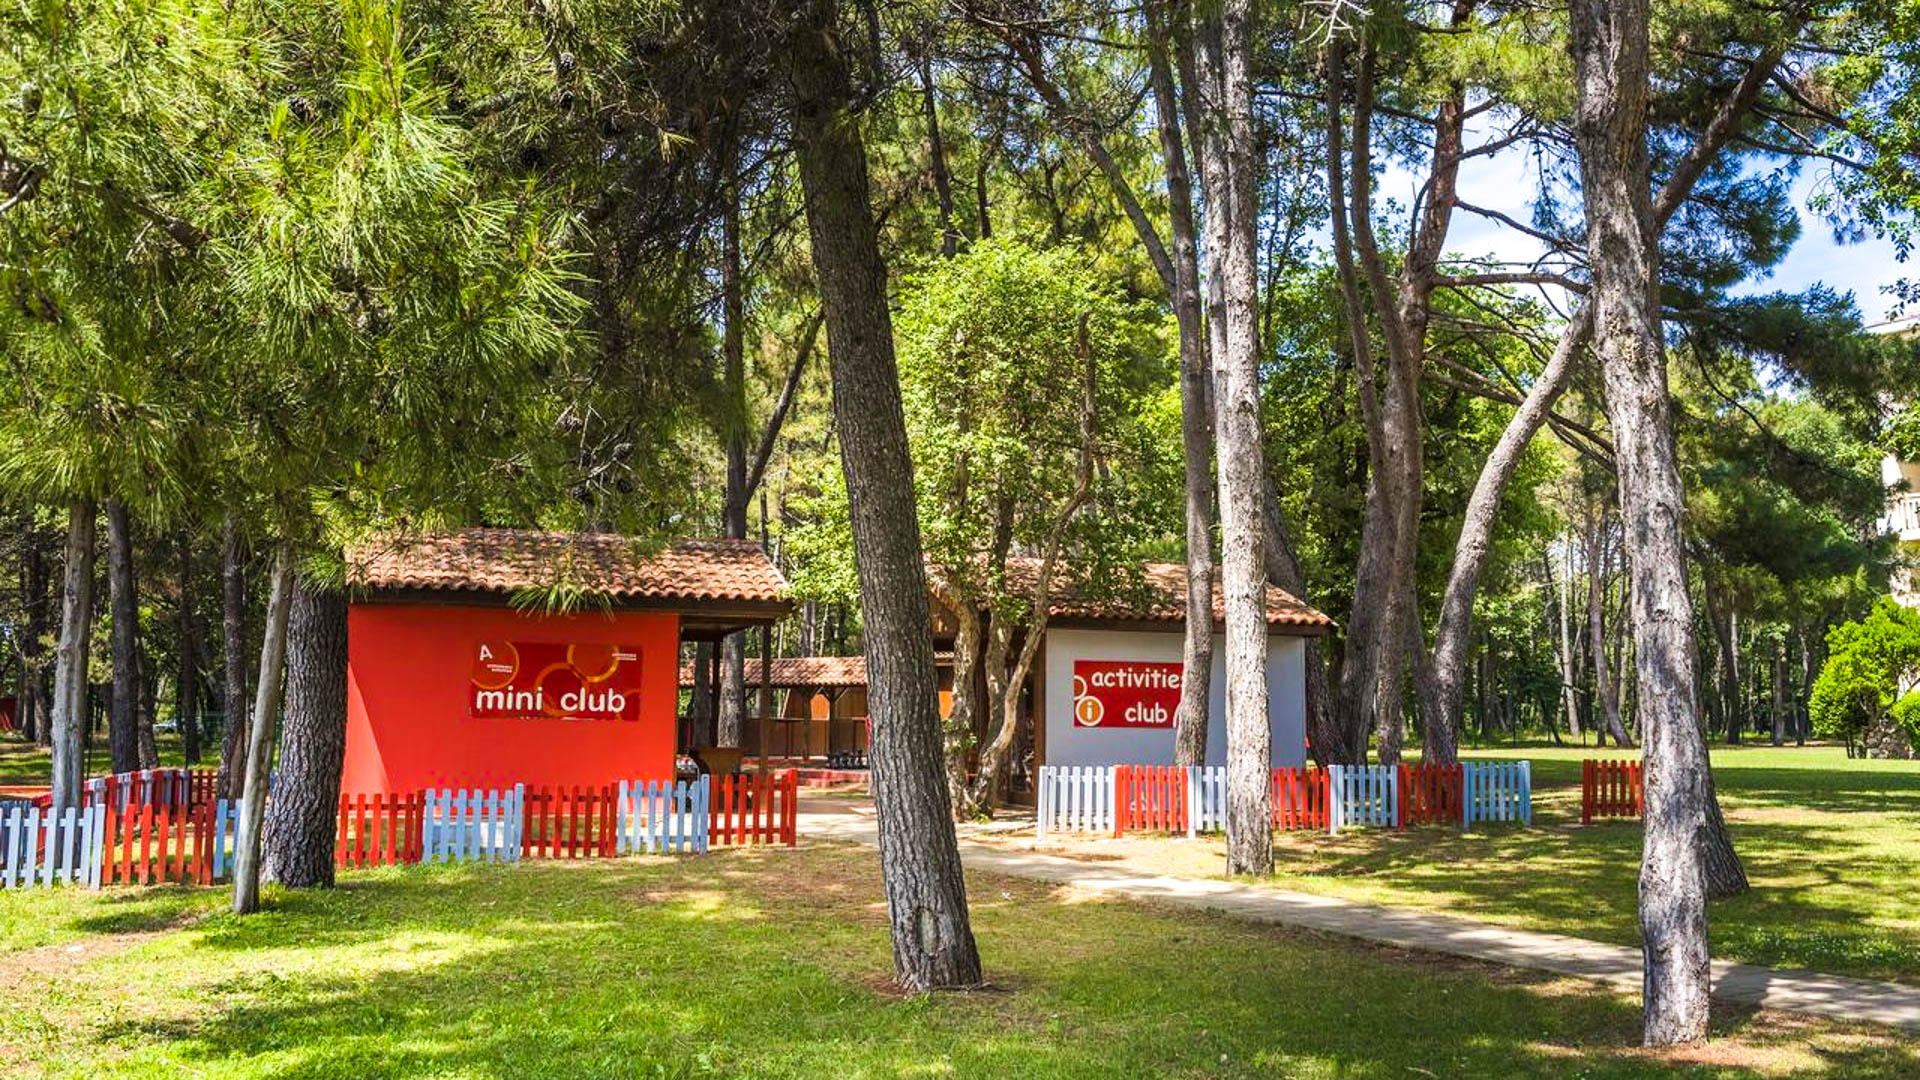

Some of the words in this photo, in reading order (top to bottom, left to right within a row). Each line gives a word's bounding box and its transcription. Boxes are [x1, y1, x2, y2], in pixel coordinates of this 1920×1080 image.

[479, 644, 493, 661] A
[476, 685, 543, 711] mini
[560, 687, 626, 712] club
[1125, 701, 1168, 723] club
